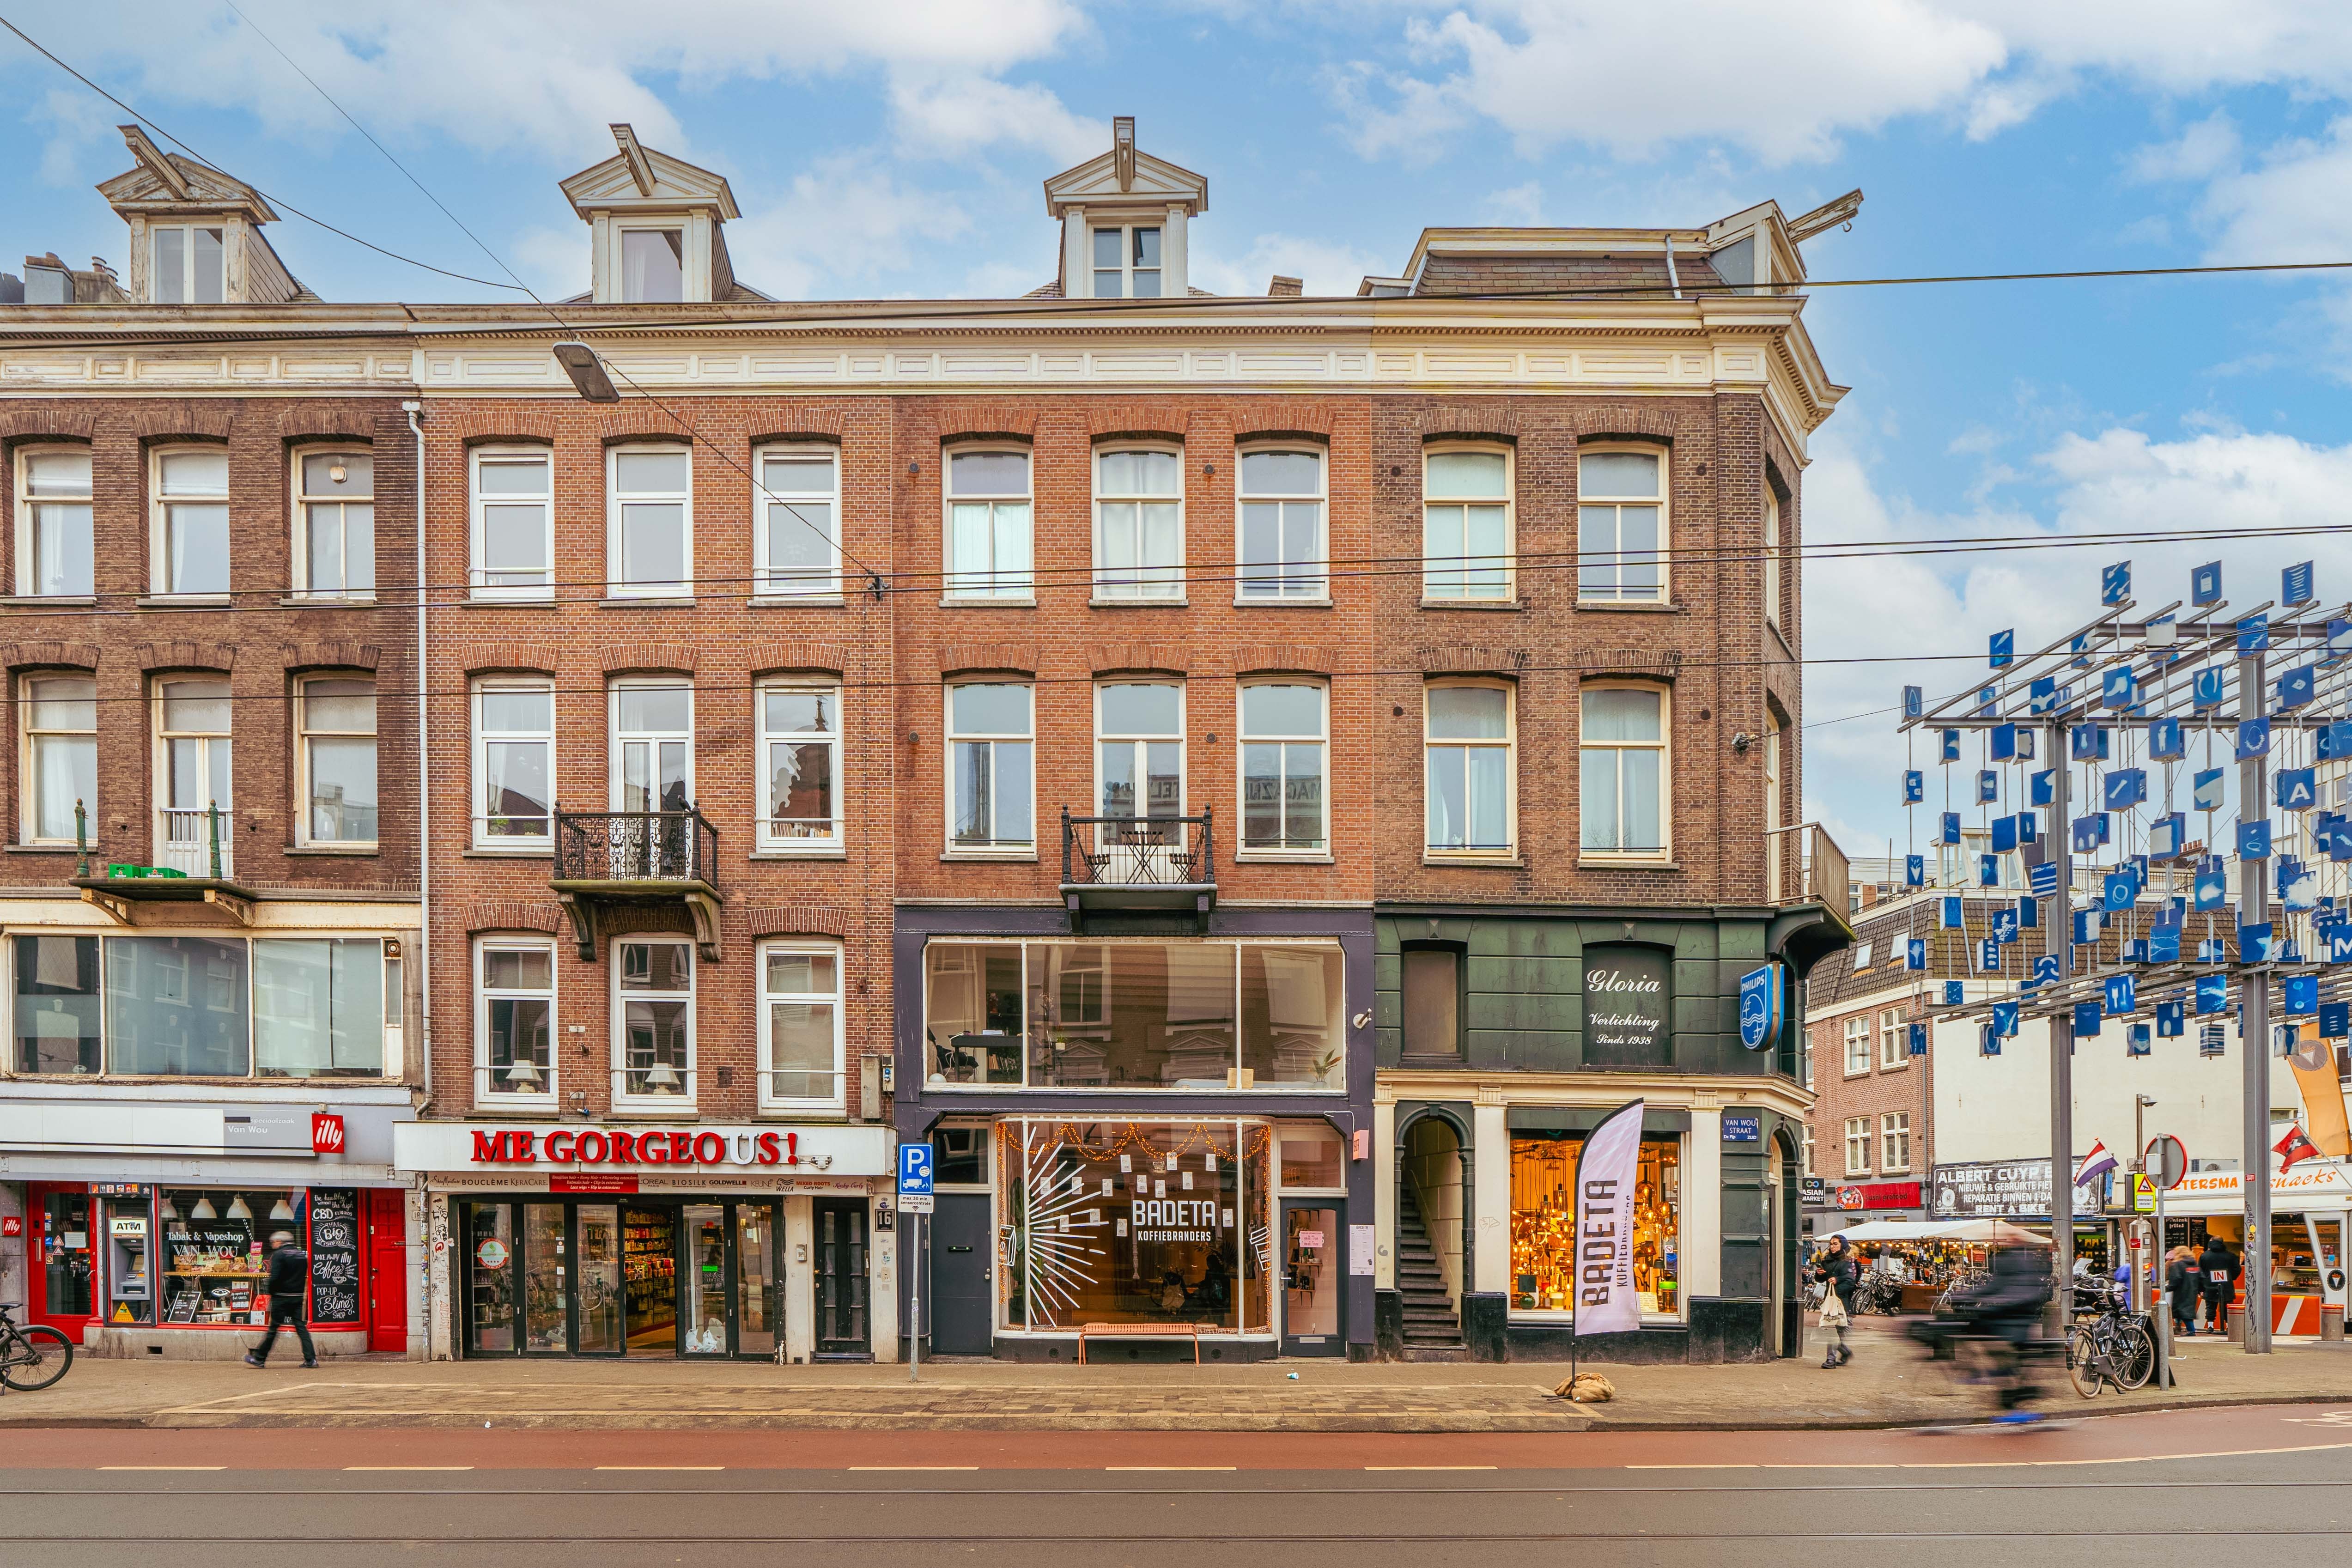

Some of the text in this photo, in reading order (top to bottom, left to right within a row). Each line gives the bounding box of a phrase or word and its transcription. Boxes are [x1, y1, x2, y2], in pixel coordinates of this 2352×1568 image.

[2288, 783, 2311, 803] A
[1587, 970, 1660, 992] Gloria
[1742, 974, 1764, 993] PHILIPS
[1589, 1013, 1659, 1031] Verlichting
[1596, 1034, 1652, 1045] Sinds 1938
[316, 1119, 343, 1150] illy
[470, 1130, 798, 1166] ME GORGEOUS!
[907, 1149, 924, 1173] P
[1938, 1169, 1993, 1183] ALBERT
[1997, 1167, 2039, 1181] CUYP
[1958, 1183, 1986, 1192] NIEUWE
[1994, 1182, 2036, 1191] GEBRUIKTE
[2038, 1181, 2052, 1190] FIET
[2173, 1177, 2238, 1191] TERSMA
[1963, 1192, 2052, 1203] REPARATIE BINNEN 1 DA
[341, 1201, 353, 1211] high
[1975, 1204, 2005, 1213] RENT
[2019, 1203, 2046, 1213] BIKE
[312, 1208, 334, 1219] CBD
[878, 1212, 891, 1225] 16
[1132, 1200, 1216, 1226] BADETA
[5, 1219, 20, 1234] illy
[167, 1232, 192, 1241] Tabak
[204, 1232, 244, 1243] Vapeshop
[323, 1228, 343, 1240] Big
[1138, 1231, 1211, 1241] KOFFIEBRANDERS
[1581, 1180, 1617, 1307] BADETA
[173, 1245, 200, 1256] VAN
[206, 1246, 239, 1257] WOU
[340, 1252, 352, 1265] illy
[313, 1261, 342, 1279] Coffee
[2214, 1271, 2224, 1280] IN
[316, 1287, 337, 1296] POP-UP
[323, 1297, 350, 1310] Slime
